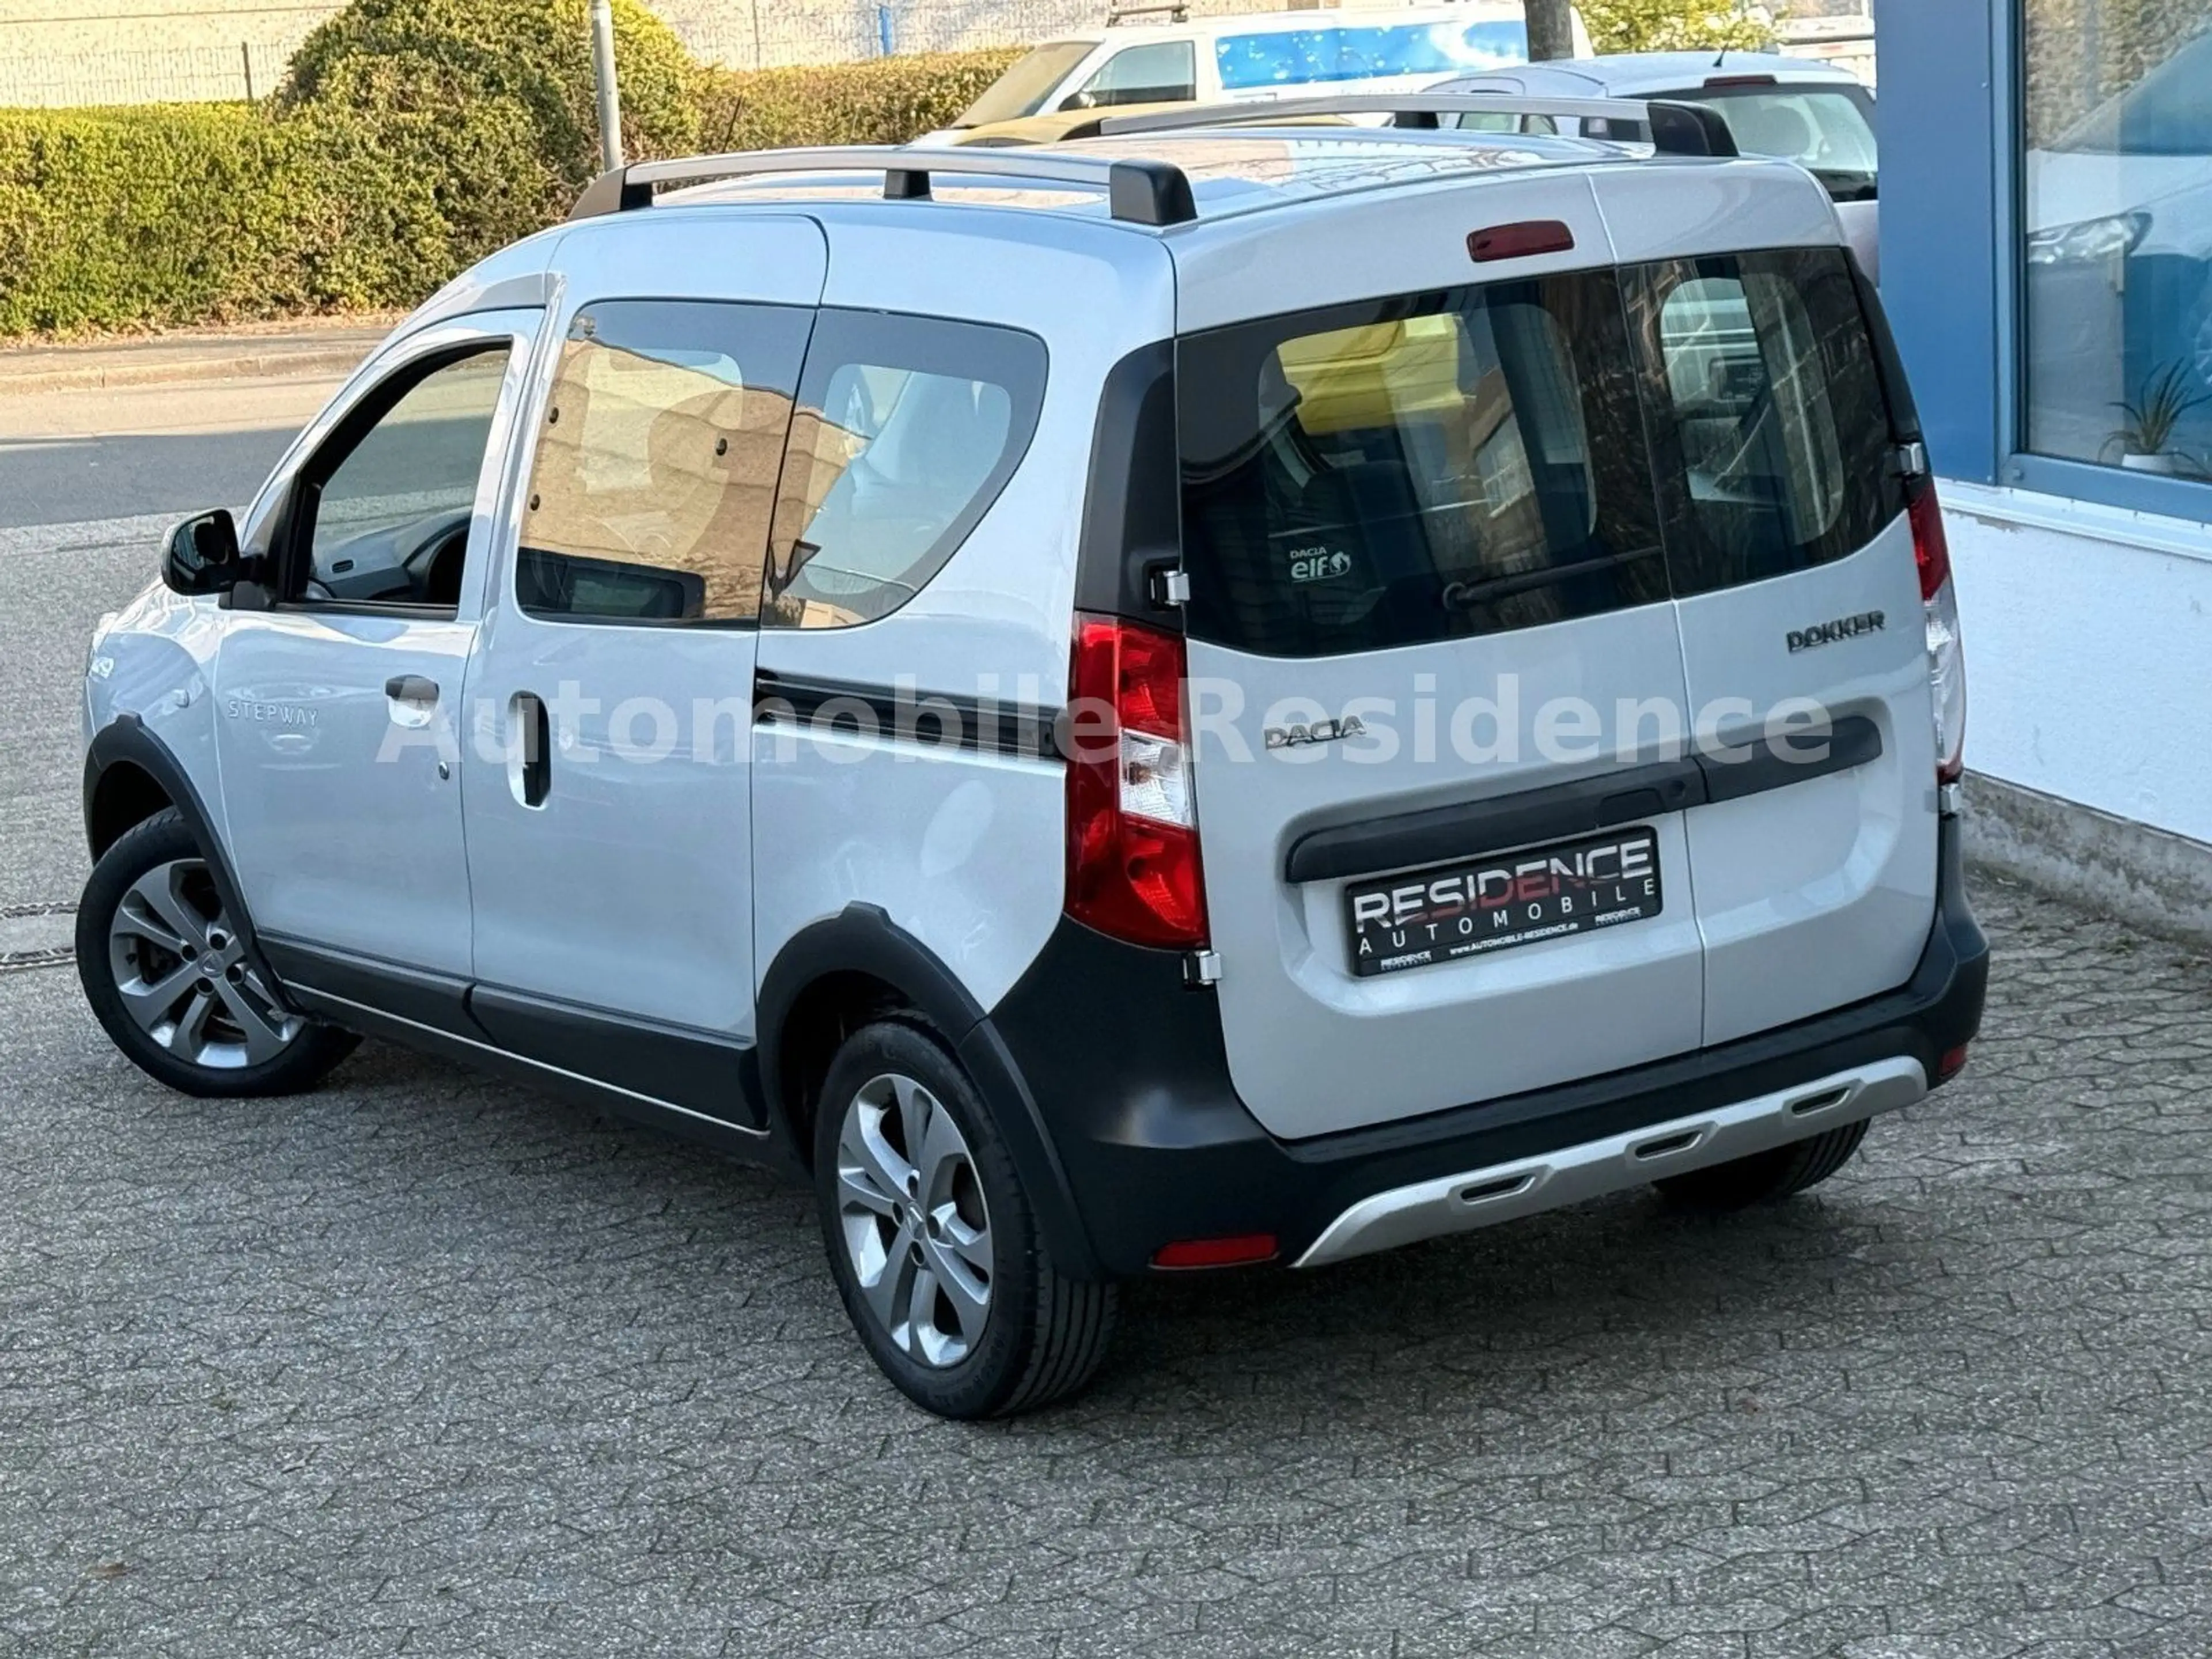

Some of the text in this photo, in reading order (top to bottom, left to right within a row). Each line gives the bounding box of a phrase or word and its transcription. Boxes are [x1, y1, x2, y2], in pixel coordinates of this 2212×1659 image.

[1290, 547, 1327, 559] DACIA
[1291, 556, 1328, 579] elf
[1786, 610, 1885, 653] DOKKER
[229, 700, 319, 726] STEPWAY
[1264, 715, 1367, 749] DACIA
[1354, 839, 1653, 933] RESIDENCE
[1359, 878, 1656, 955] AUTOMOBILE
